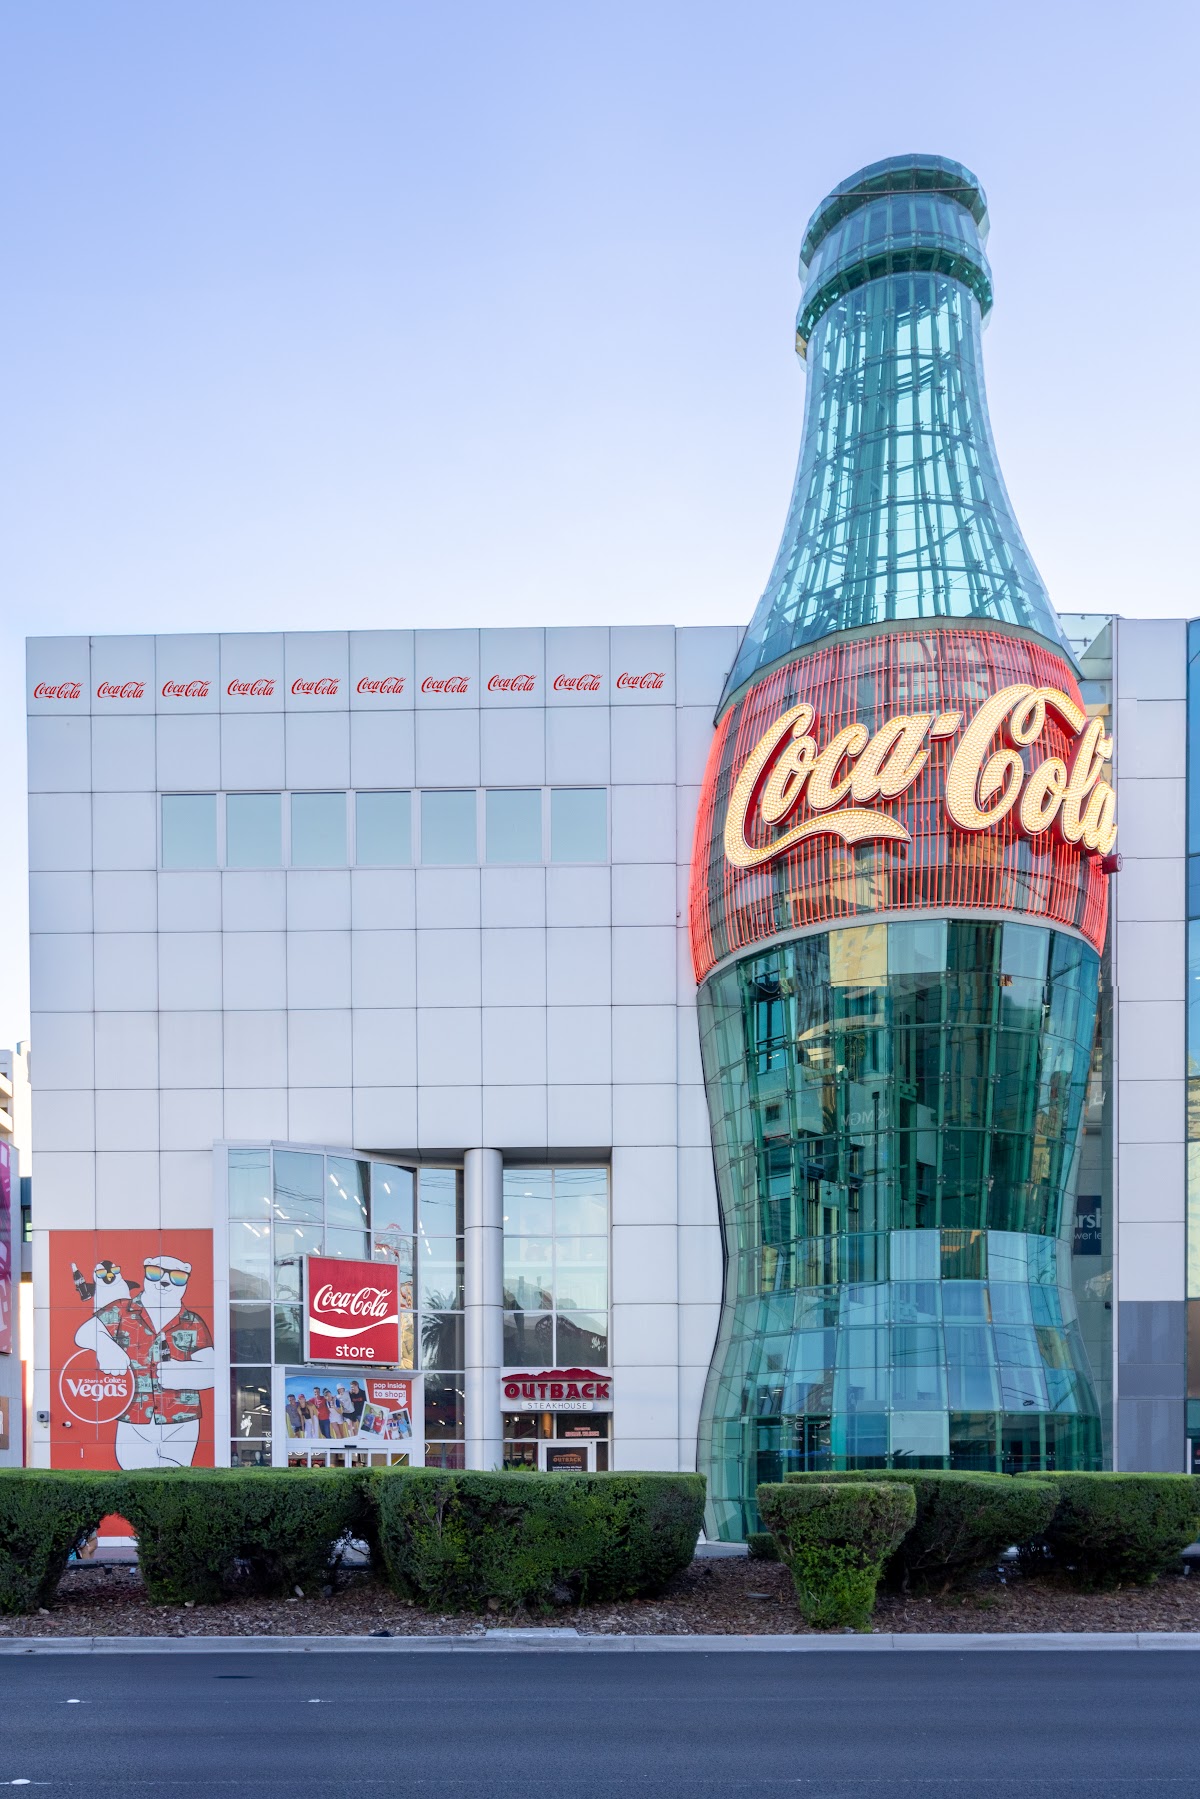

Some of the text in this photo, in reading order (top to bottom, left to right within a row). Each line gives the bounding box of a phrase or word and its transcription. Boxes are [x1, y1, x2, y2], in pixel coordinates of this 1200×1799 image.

[162, 680, 212, 697] Coca-Cola
[227, 679, 277, 696] Coca-Cola
[291, 678, 341, 695] Coca-Cola
[356, 677, 406, 694] Coca-Cola
[421, 676, 470, 693] Coca-Cola
[487, 674, 537, 692] Coca-Cola
[553, 674, 603, 692] Coca-Cola
[616, 672, 666, 690] Coca-Cola
[34, 682, 84, 699] Coca-Cola
[97, 682, 147, 699] Coca-Cola
[724, 683, 1118, 869] Coca-Cola
[313, 1283, 392, 1317] Coca-Cola
[335, 1343, 375, 1358] store
[103, 1376, 121, 1384] Coke
[373, 1382, 407, 1390] pop inside
[65, 1378, 128, 1402] Vegas
[384, 1391, 406, 1399] shop!
[504, 1383, 610, 1400] OUTBACK
[527, 1402, 588, 1410] STEAKHOUSE
